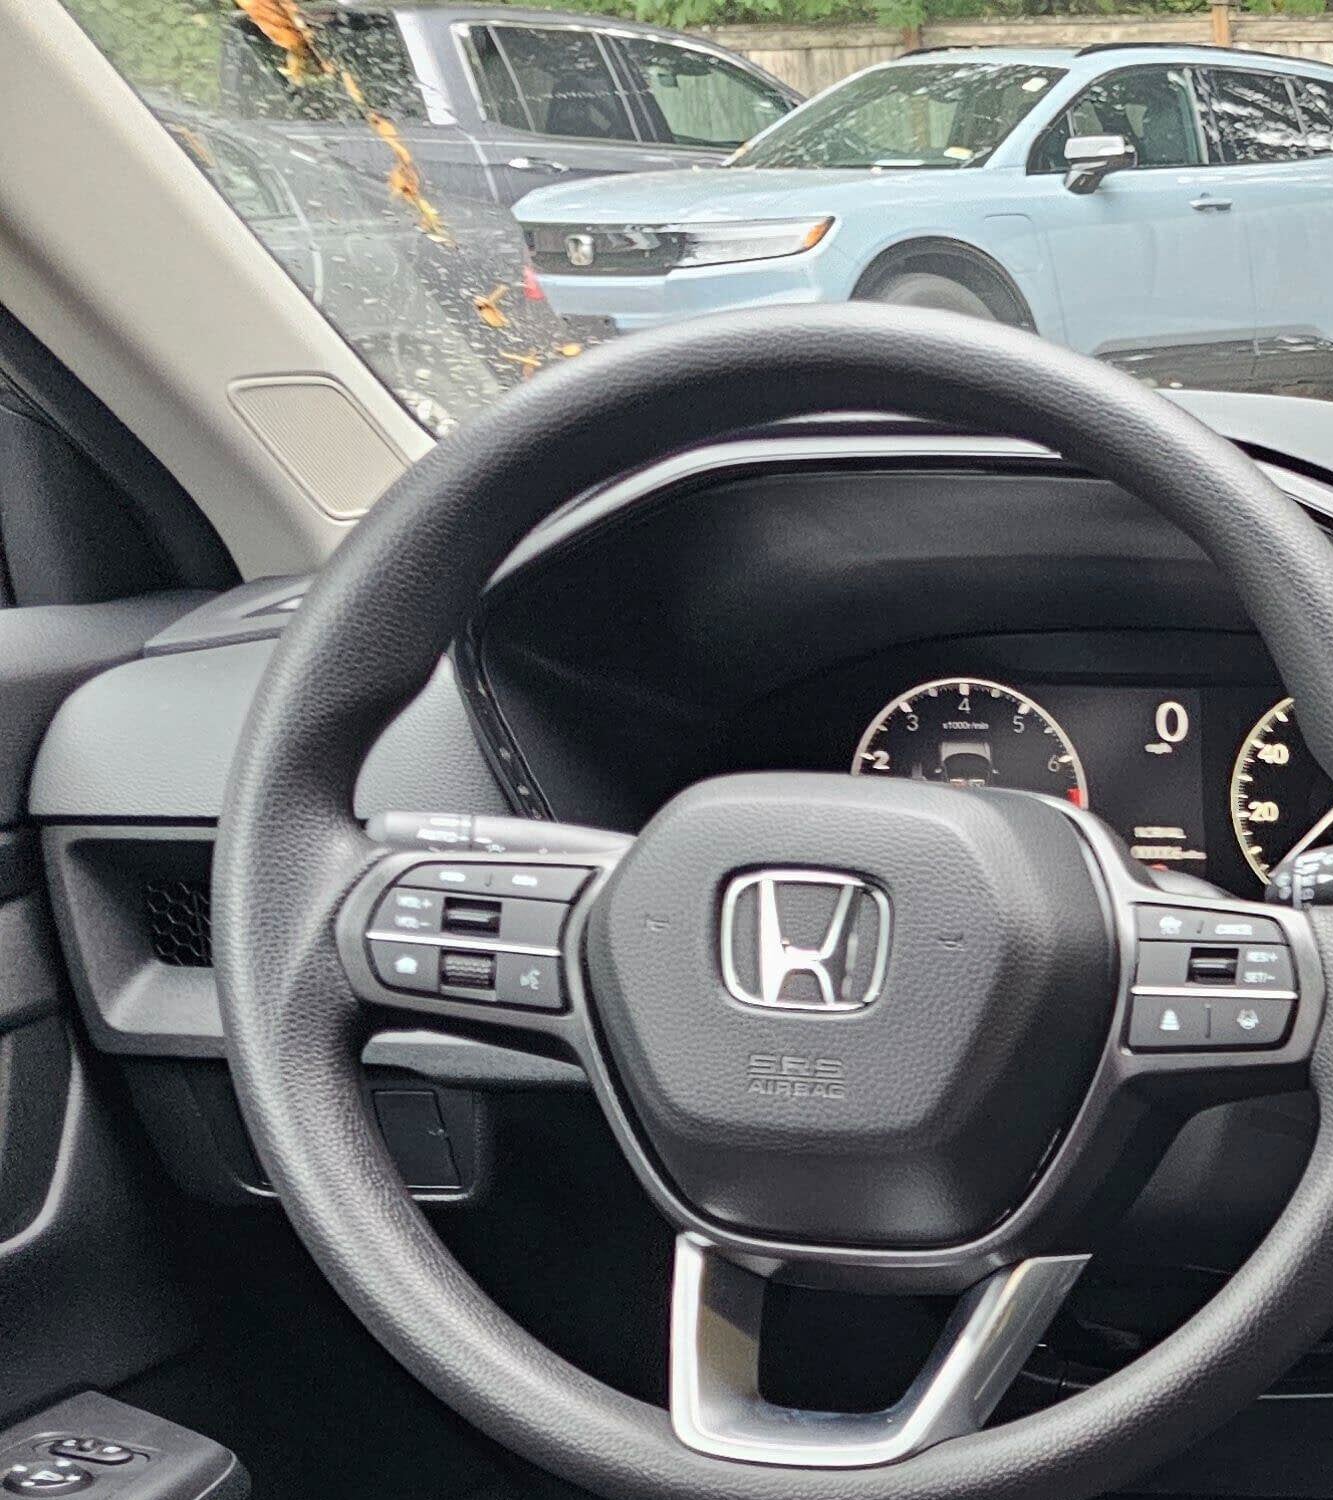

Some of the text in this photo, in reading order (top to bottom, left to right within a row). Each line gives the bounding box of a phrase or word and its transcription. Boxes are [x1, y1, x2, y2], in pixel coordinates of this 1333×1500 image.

[958, 698, 971, 714] 4
[906, 714, 920, 731] 3
[1012, 716, 1025, 734] 5
[1155, 701, 1189, 743] 0
[872, 750, 890, 770] 2
[1047, 754, 1060, 772] 6
[1257, 743, 1290, 764] 40
[1248, 800, 1280, 822] 20
[748, 1078, 845, 1099] AIRBAG
